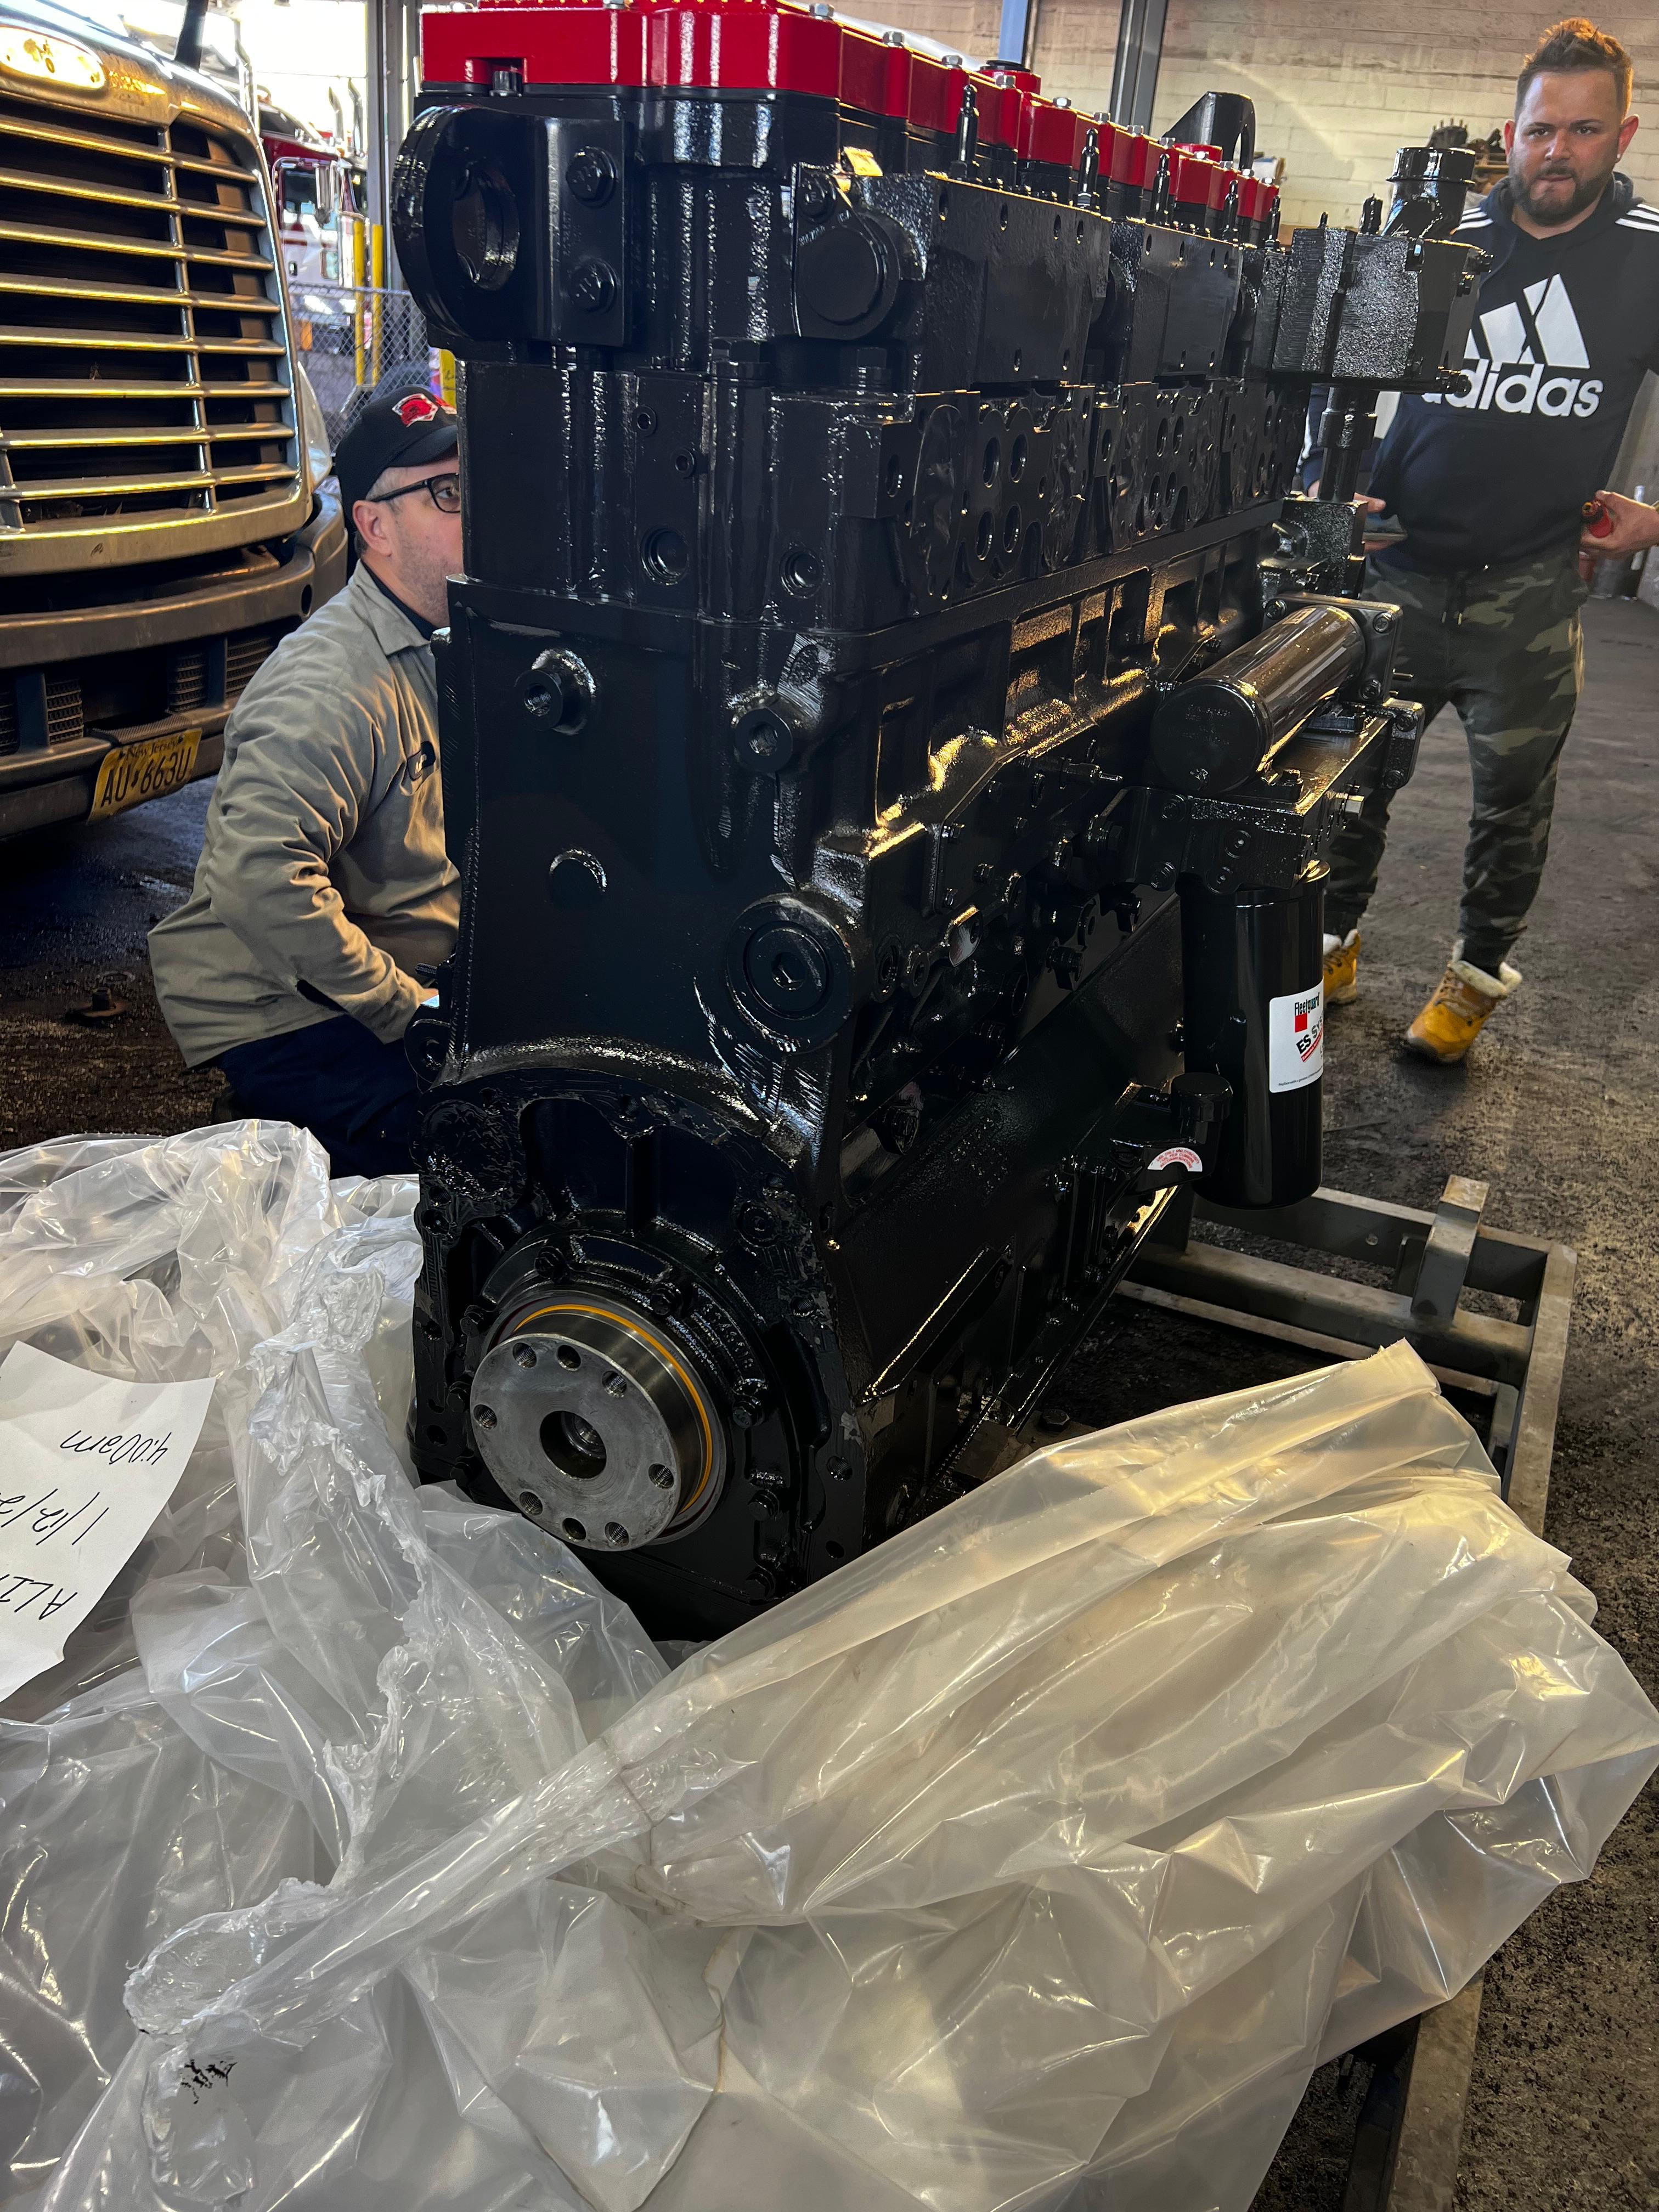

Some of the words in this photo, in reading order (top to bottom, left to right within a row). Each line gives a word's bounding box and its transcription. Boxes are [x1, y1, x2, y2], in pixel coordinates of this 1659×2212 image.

[1421, 359, 1604, 417] didas
[1294, 992, 1319, 1017] Fleetguard
[1296, 1034, 1311, 1054] ES
